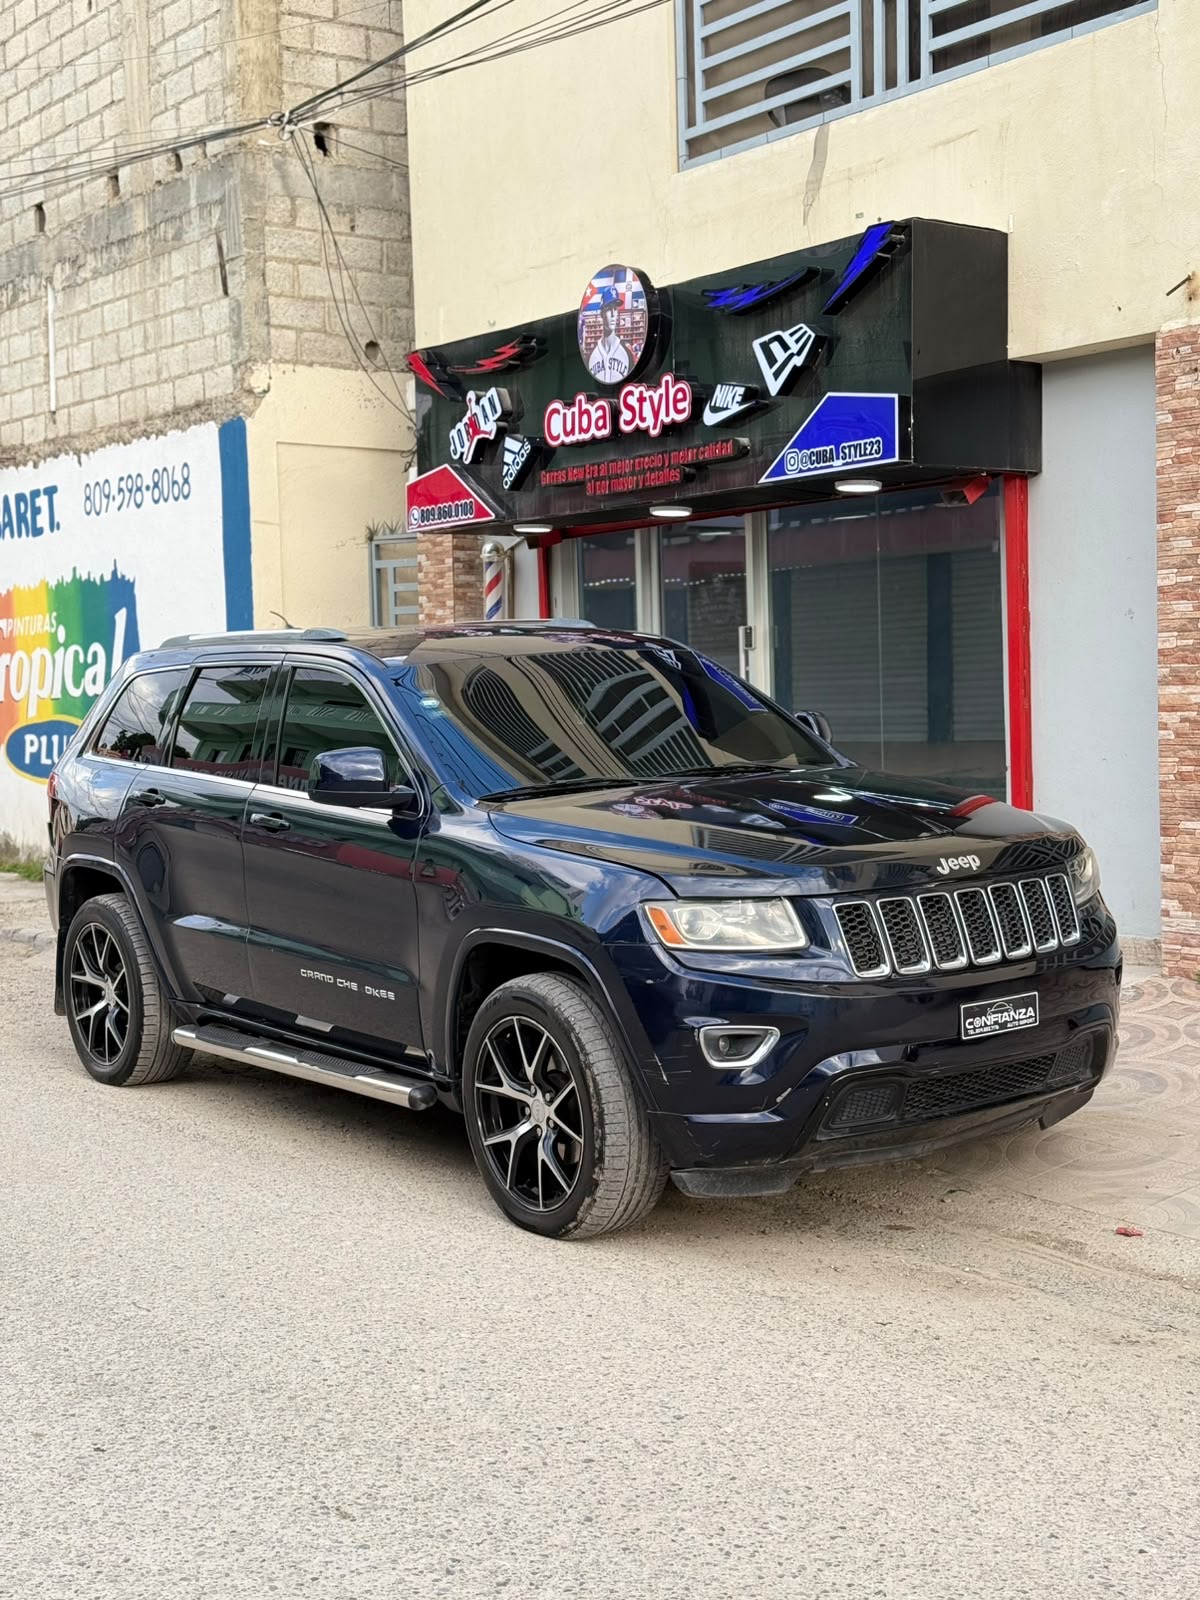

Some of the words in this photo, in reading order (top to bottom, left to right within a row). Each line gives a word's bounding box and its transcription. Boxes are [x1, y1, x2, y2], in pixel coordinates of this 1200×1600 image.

[711, 384, 746, 408] NIKE
[546, 394, 610, 445] Cuba
[621, 377, 690, 434] Style
[503, 442, 531, 489] adidas
[585, 464, 598, 479] Era
[599, 462, 608, 475] al
[671, 447, 697, 464] mejor
[699, 440, 733, 459] calidad
[644, 468, 680, 485] detalles
[0, 485, 60, 540] ARET.
[420, 501, 474, 523] 809.860.0108
[7, 612, 57, 638] PINTURAS
[0, 607, 127, 719] ropical
[24, 734, 74, 765] PLU
[936, 854, 981, 875] Jeep
[300, 968, 334, 984] GRAND
[965, 1006, 1035, 1029] CONFIANZA
